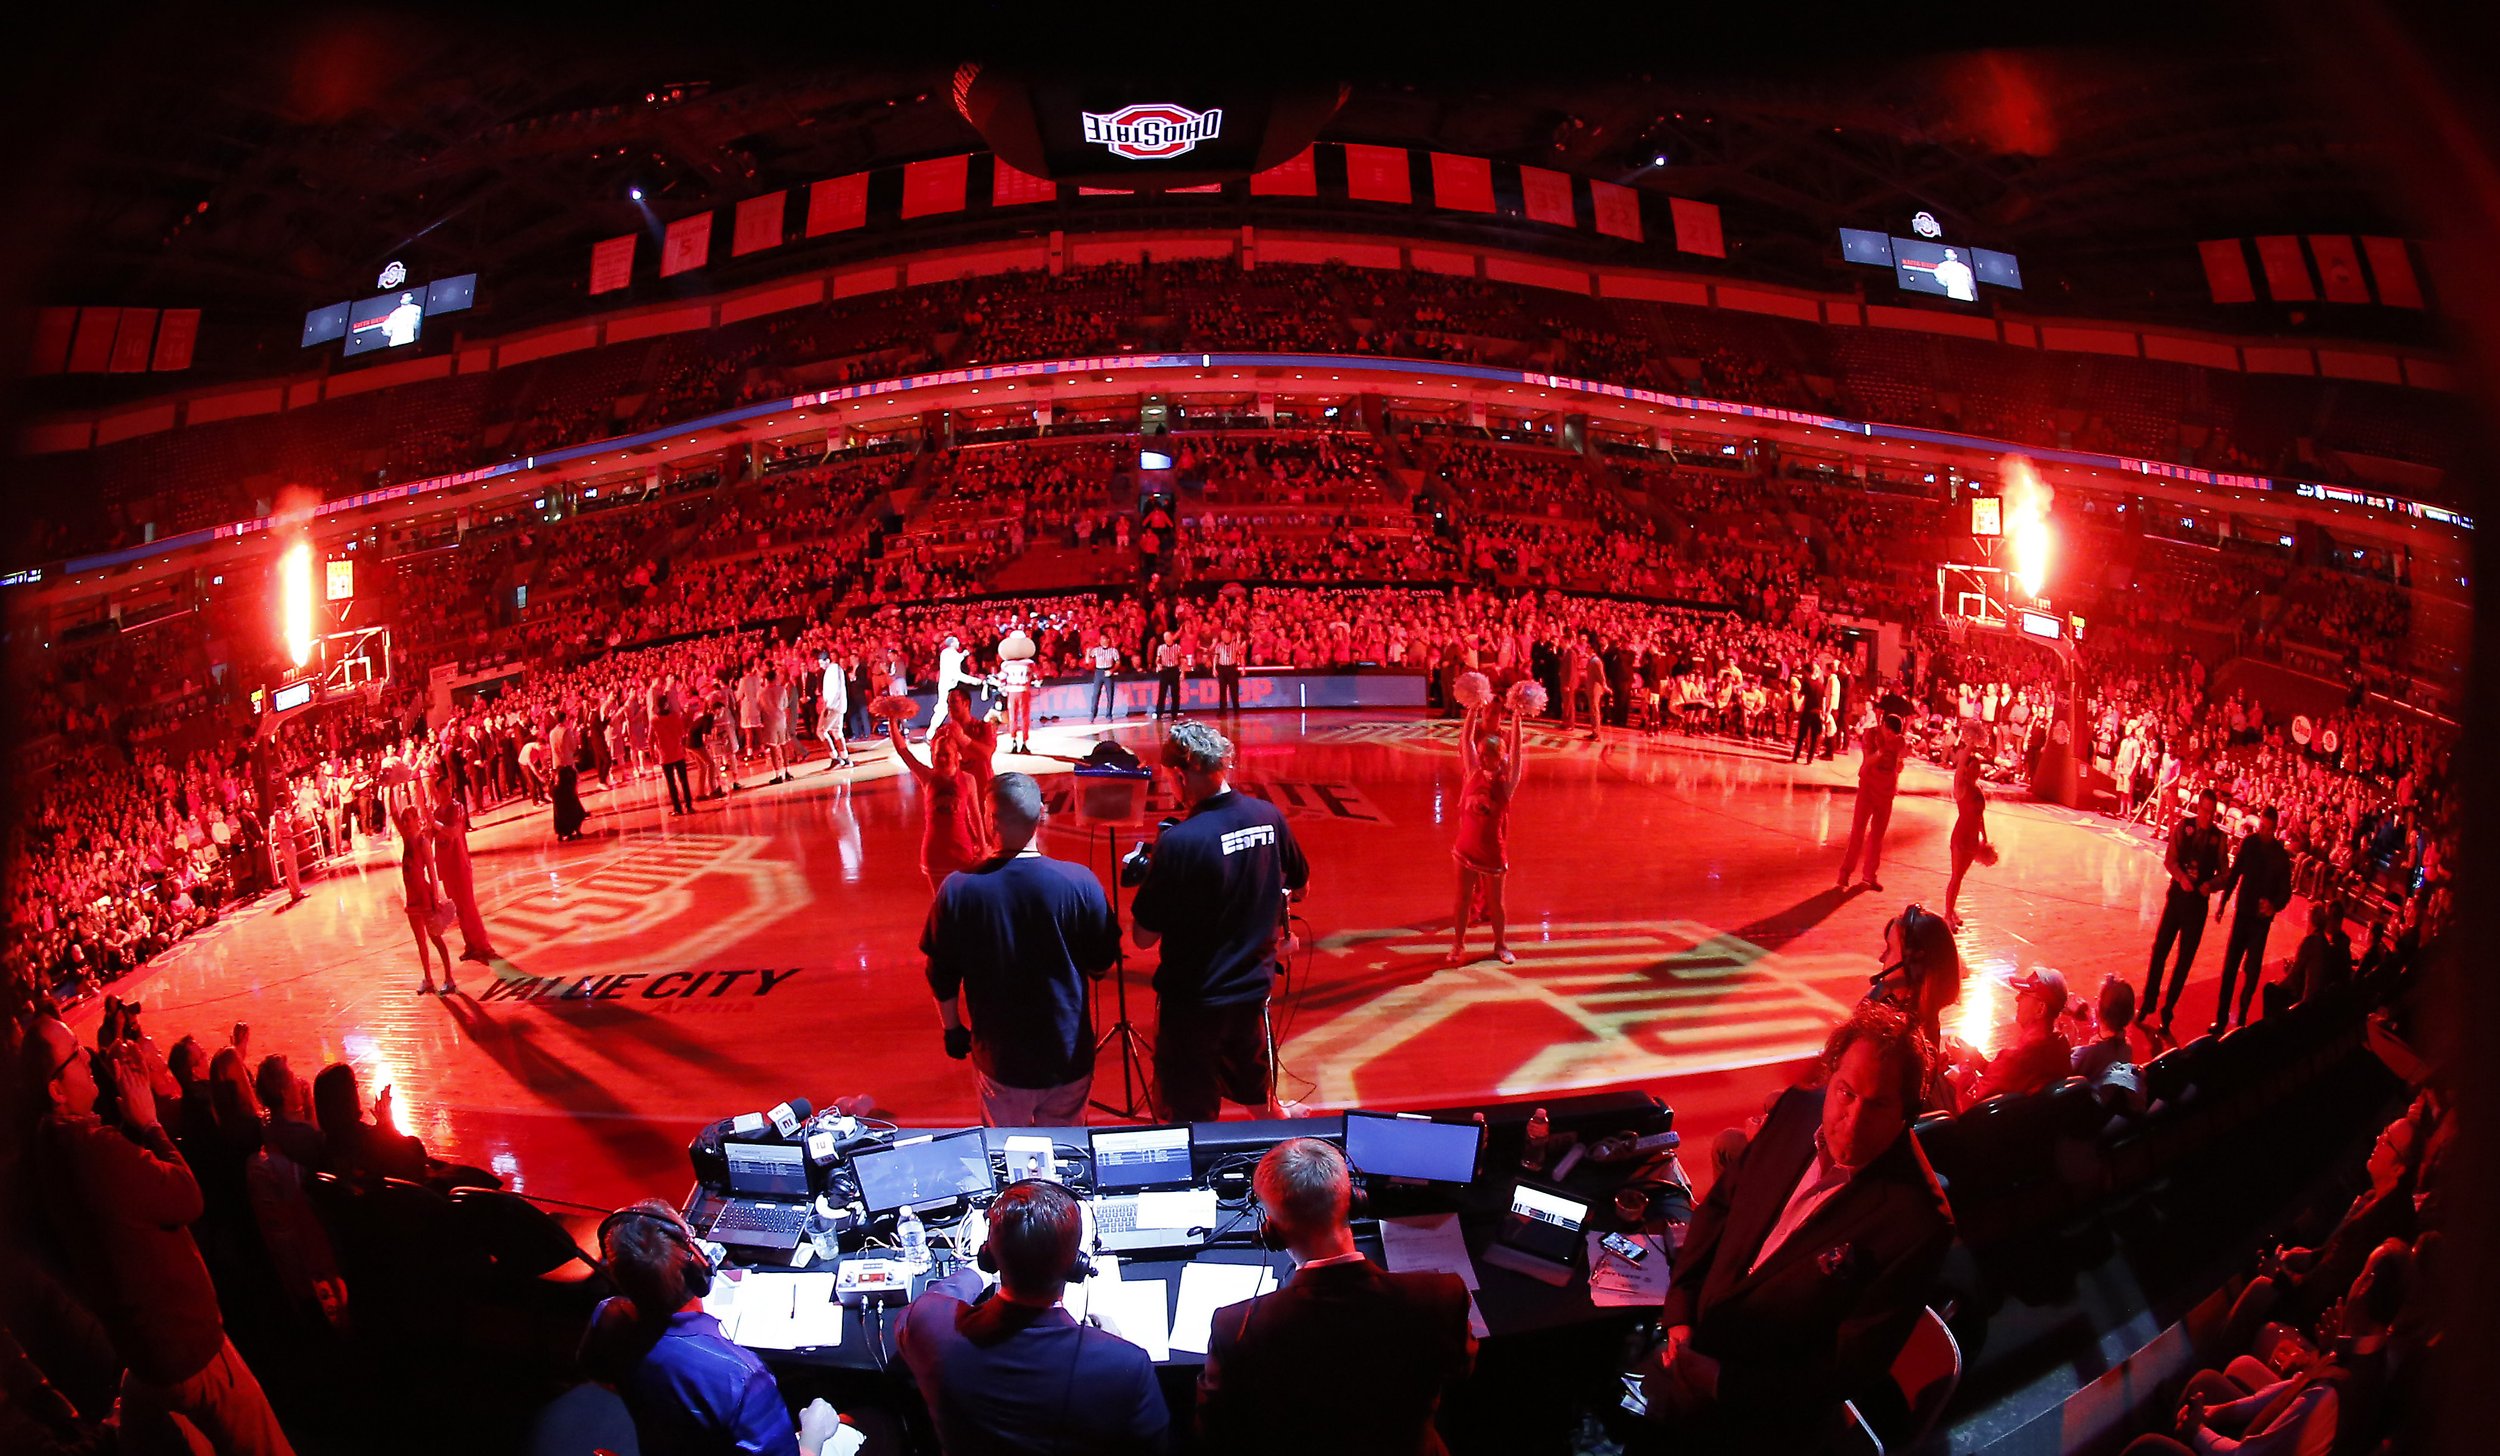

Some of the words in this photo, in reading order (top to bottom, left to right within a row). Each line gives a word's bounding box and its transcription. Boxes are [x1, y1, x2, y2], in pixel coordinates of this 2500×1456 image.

[1220, 823, 1276, 857] ESPN
[479, 972, 649, 1002] VALUE
[640, 966, 805, 1001] CITY
